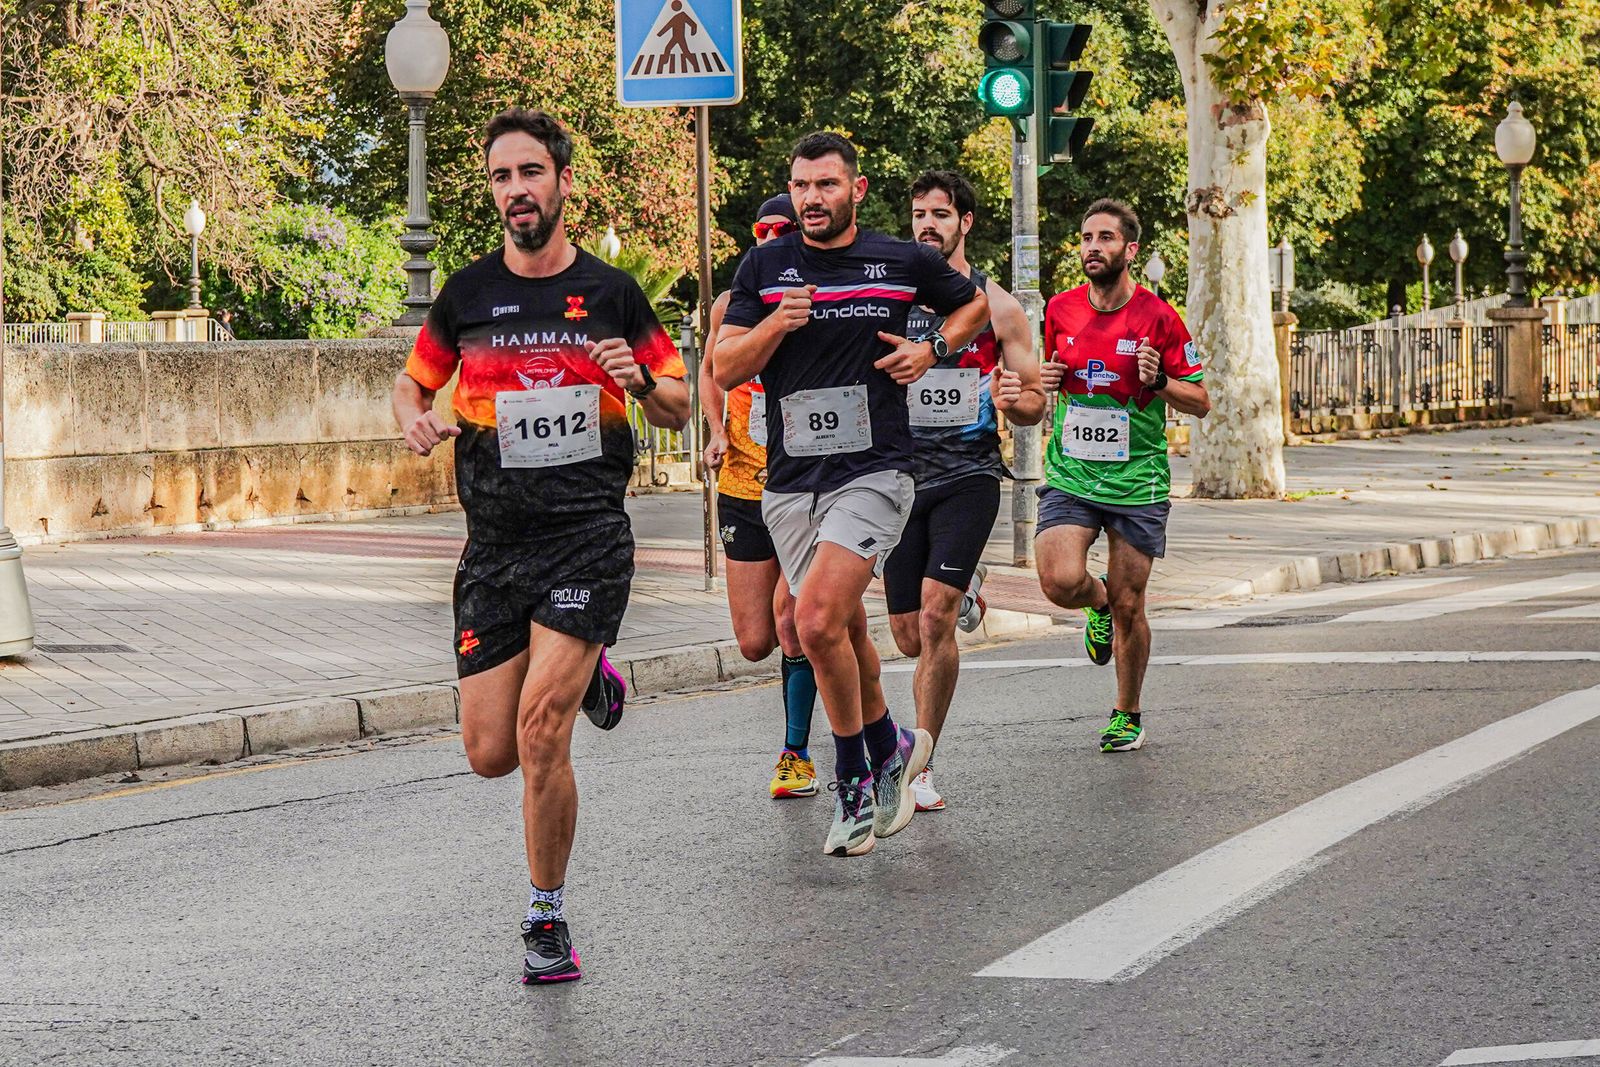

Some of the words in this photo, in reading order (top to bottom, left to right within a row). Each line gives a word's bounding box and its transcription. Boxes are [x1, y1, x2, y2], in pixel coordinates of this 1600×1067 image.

[492, 331, 588, 348] HAMMAM
[1087, 360, 1115, 380] Poncho
[920, 388, 962, 406] 639
[514, 411, 587, 440] 1612
[808, 411, 839, 432] 89
[1072, 425, 1119, 443] 1882
[550, 588, 591, 603] TRICLUB
